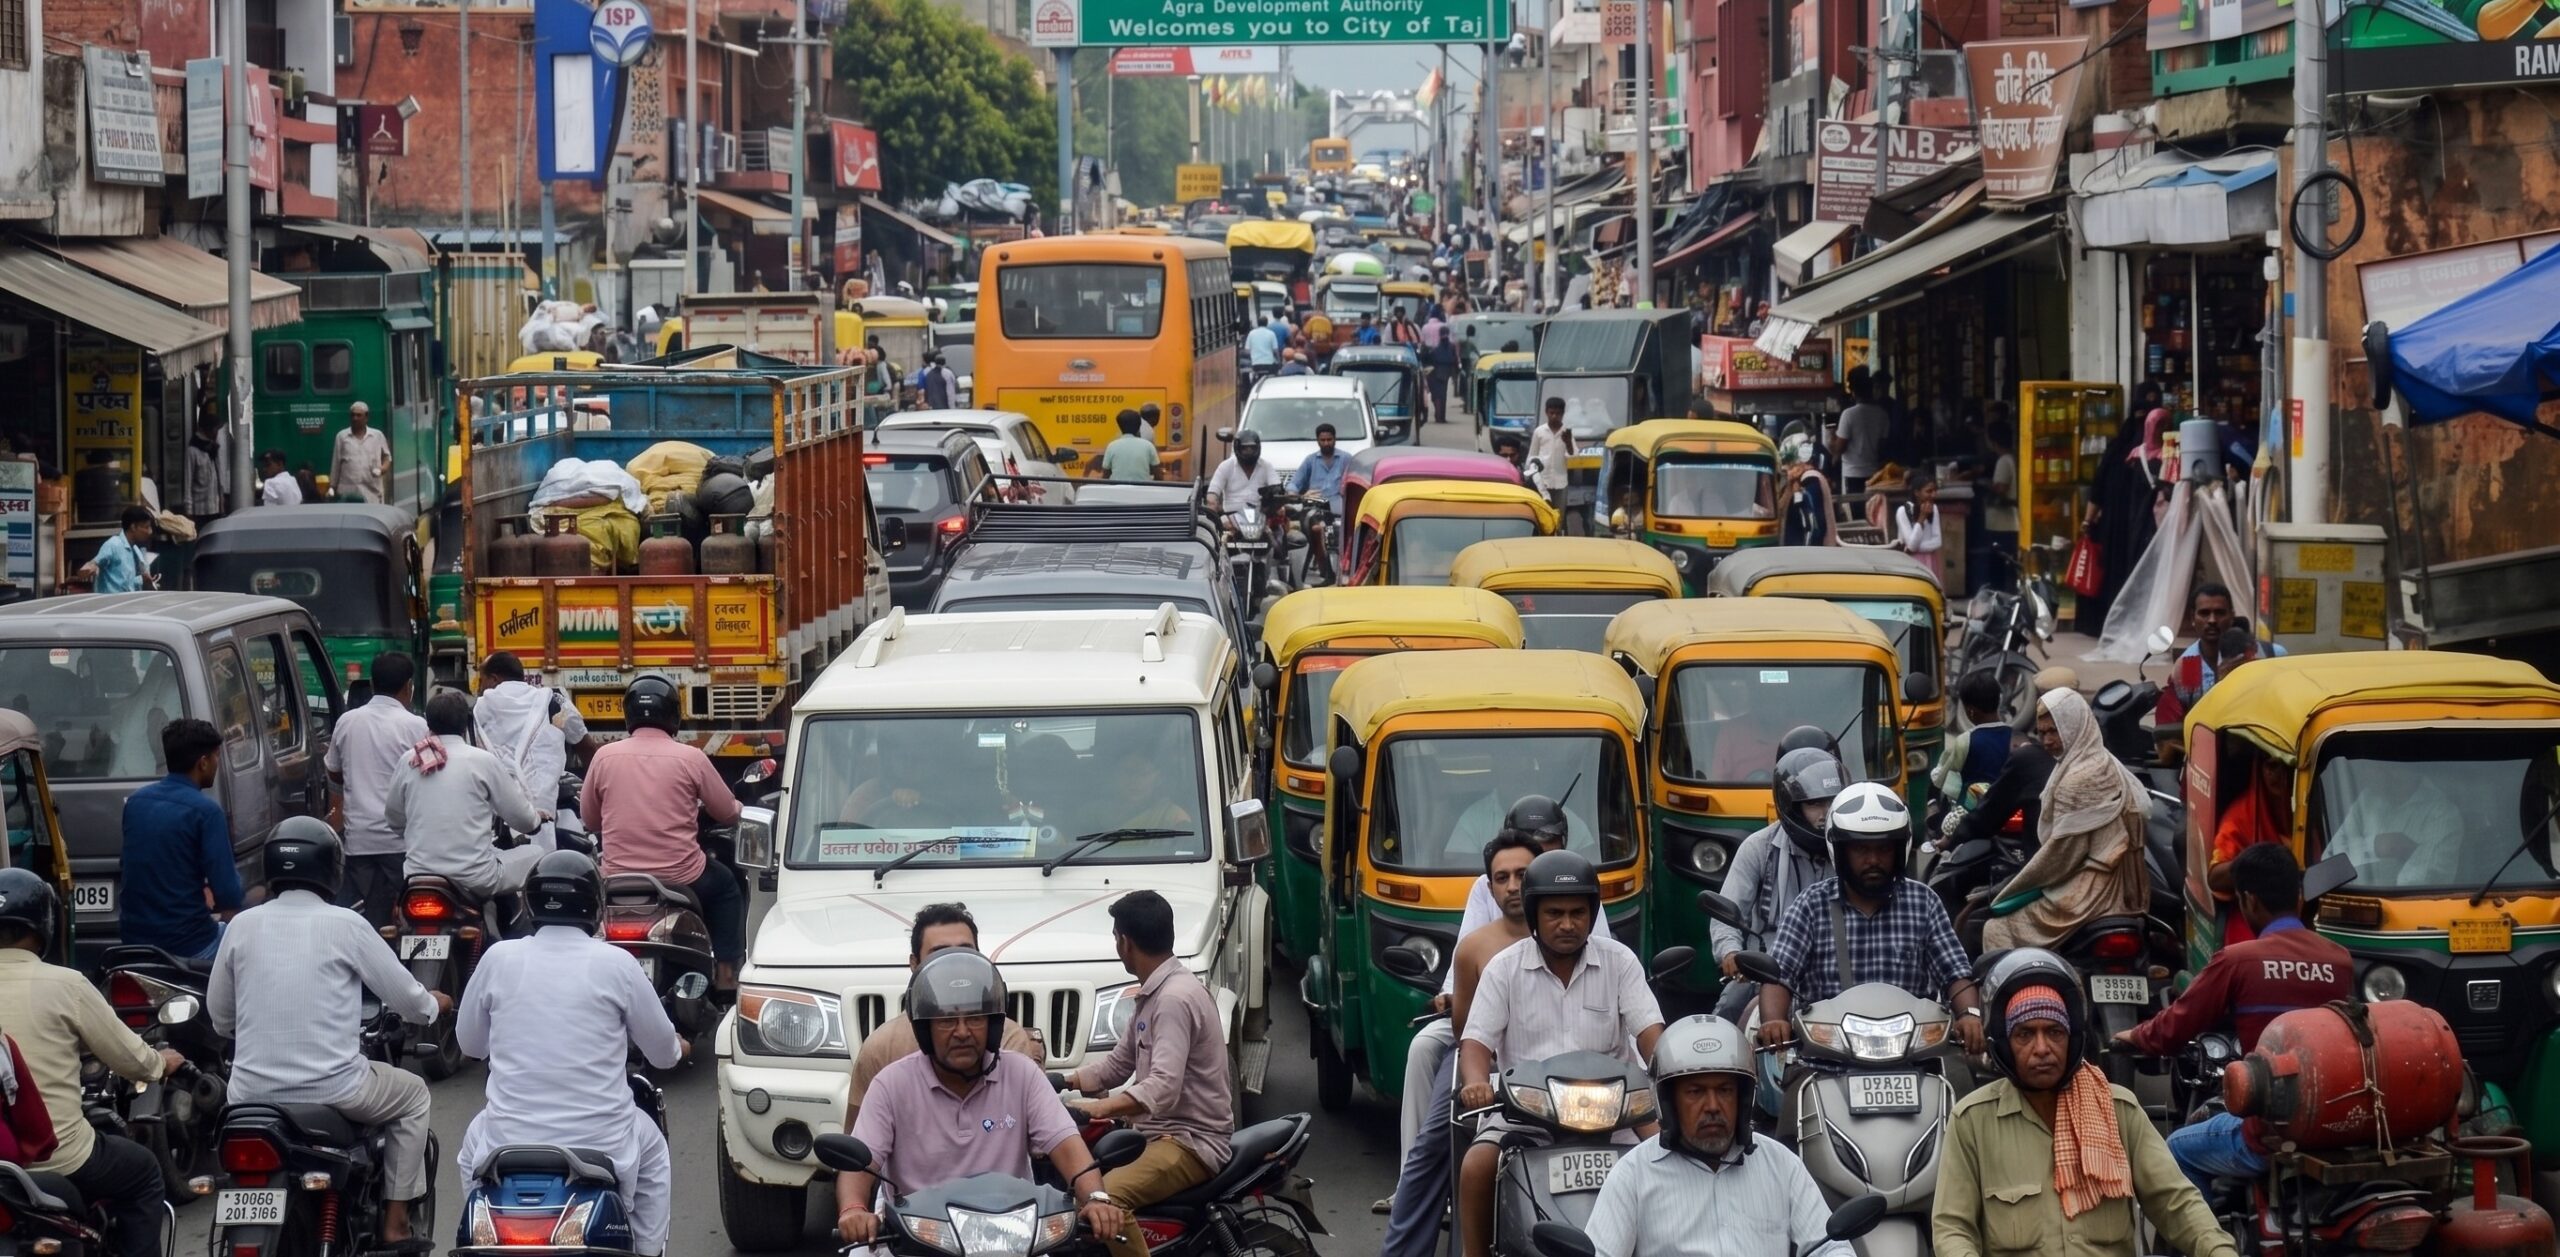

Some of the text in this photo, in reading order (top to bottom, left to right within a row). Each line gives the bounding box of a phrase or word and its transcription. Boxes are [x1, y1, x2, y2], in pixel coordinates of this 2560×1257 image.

[605, 8, 635, 26] ISP
[1162, 0, 1424, 17] Agra Development Authority
[1109, 16, 1482, 38] Welcomes you to City of Taj
[2515, 44, 2560, 76] RAM
[76, 887, 109, 906] 089
[2262, 960, 2335, 984] RPGAS
